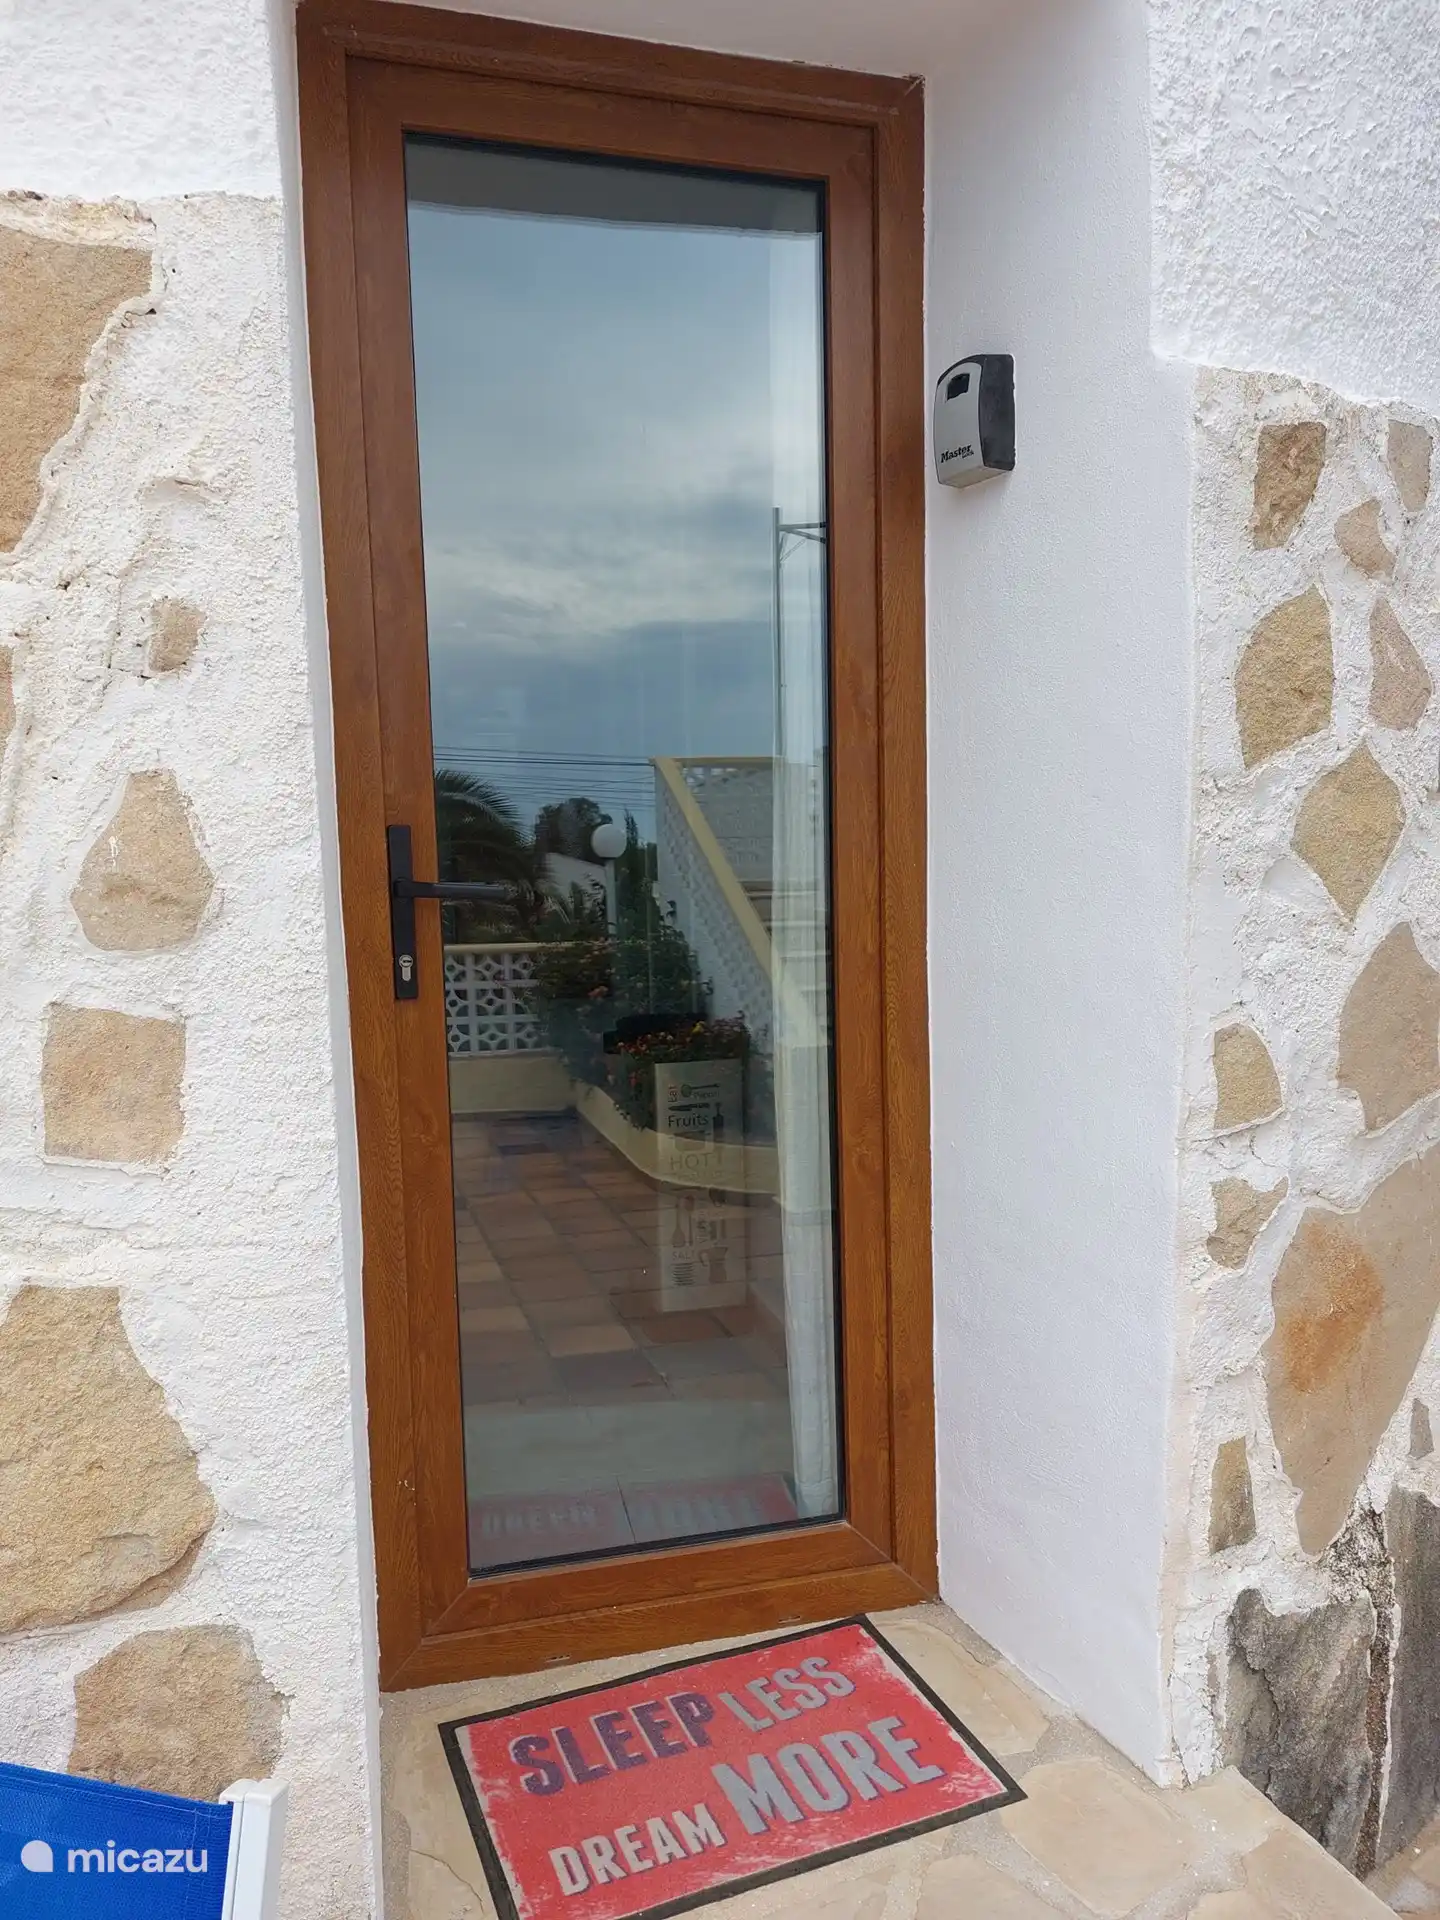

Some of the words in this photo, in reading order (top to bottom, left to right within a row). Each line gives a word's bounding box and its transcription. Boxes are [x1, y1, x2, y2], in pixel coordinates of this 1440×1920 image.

[940, 445, 972, 463] Master
[668, 1113, 709, 1128] Fruits
[670, 1152, 714, 1171] HOT
[508, 1691, 715, 1796] SLEEP
[718, 1656, 856, 1733] LESS
[547, 1802, 728, 1897] DREAM
[711, 1715, 948, 1836] MORE
